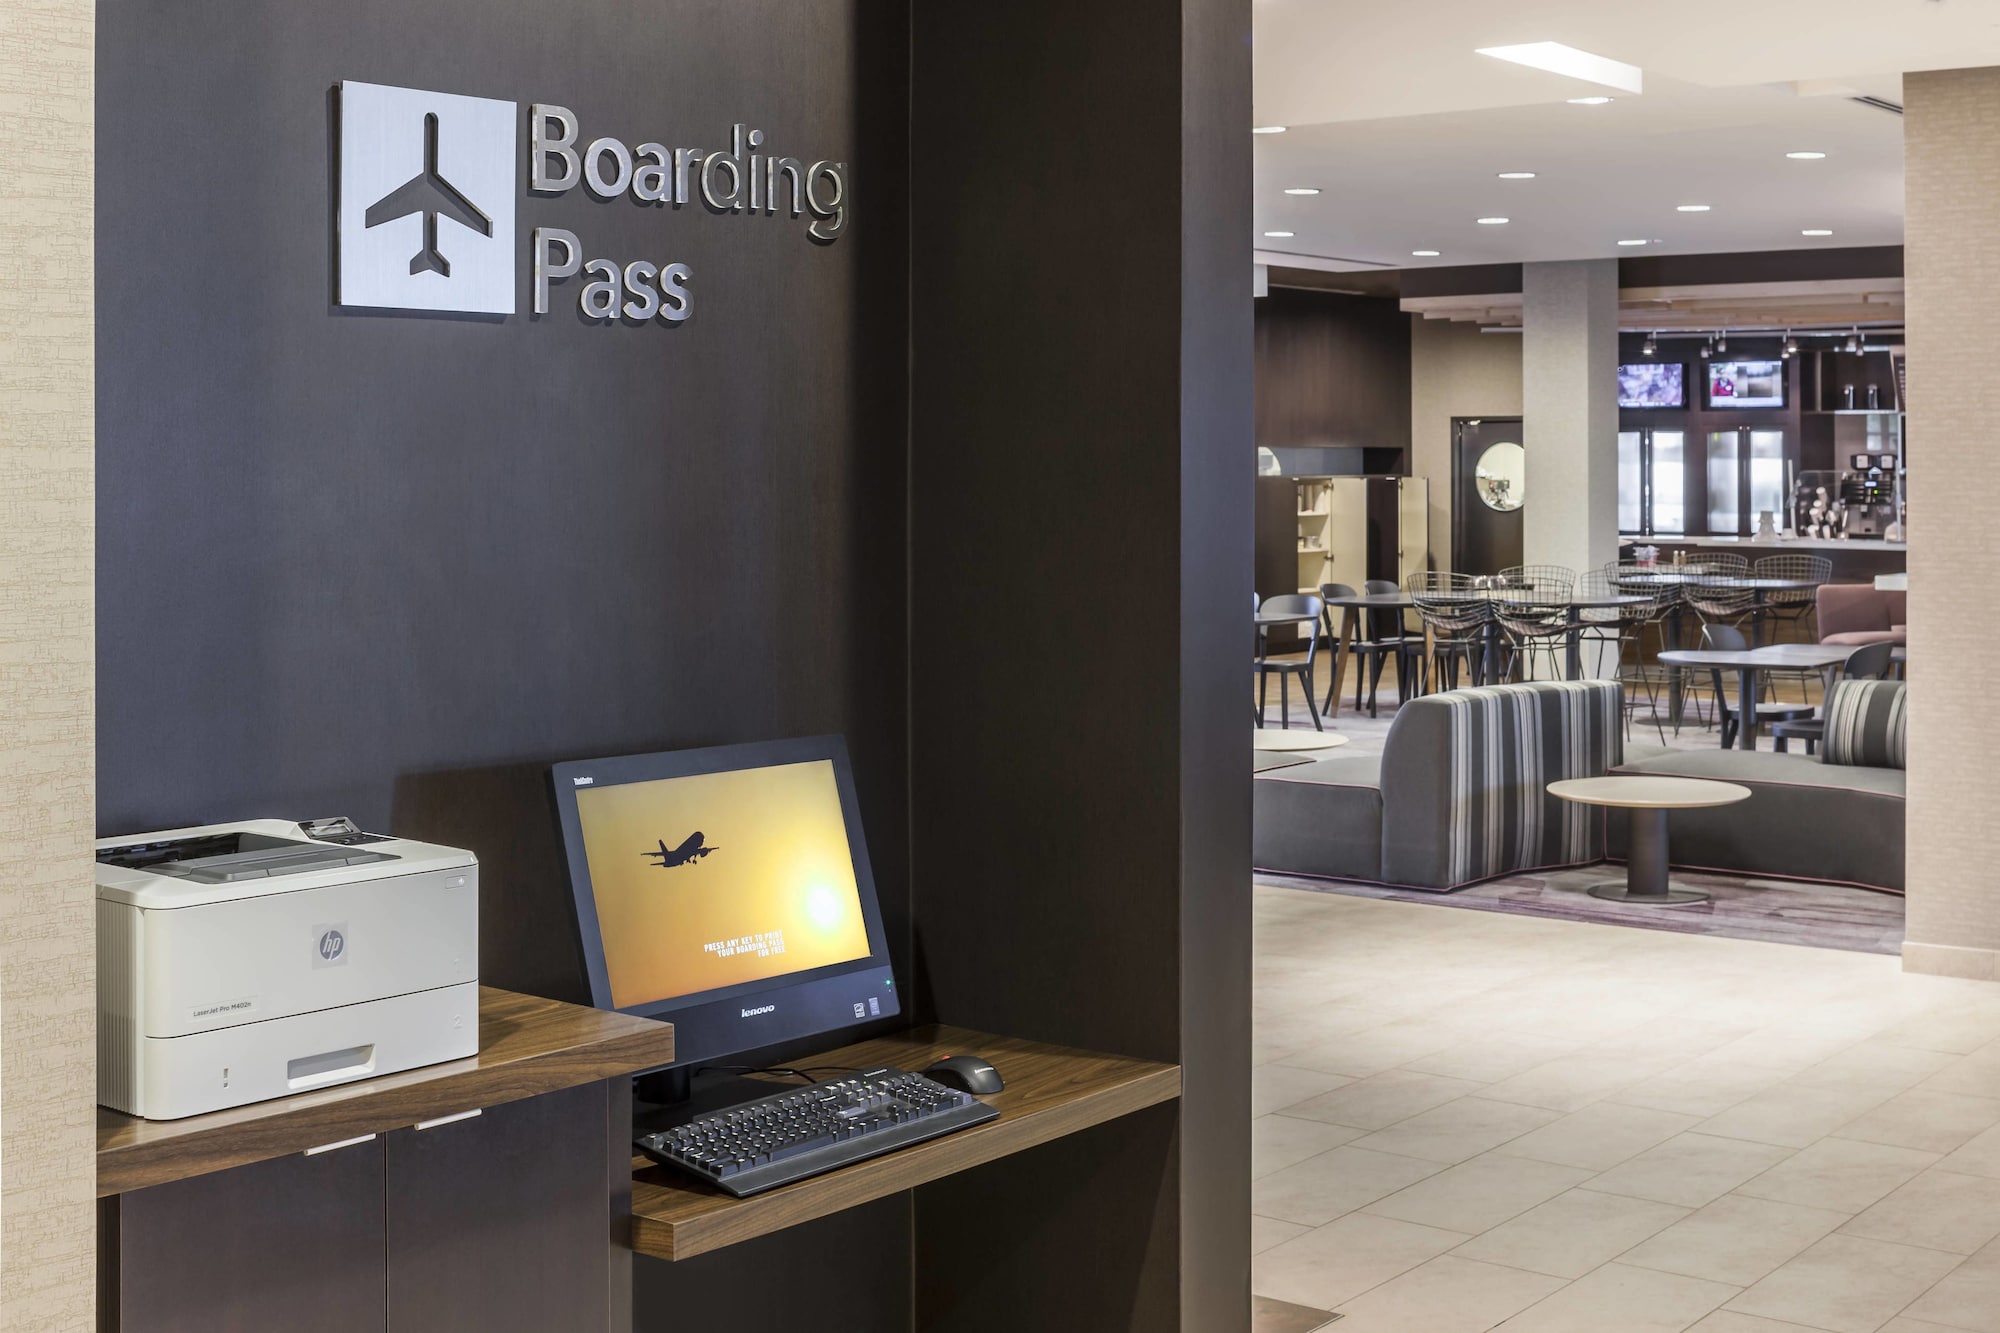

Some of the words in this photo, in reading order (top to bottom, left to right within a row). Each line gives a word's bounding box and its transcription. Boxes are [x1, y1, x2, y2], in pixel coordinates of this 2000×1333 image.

[530, 103, 848, 240] Boarding
[534, 227, 694, 321] Pass
[322, 930, 342, 960] hp
[704, 942, 725, 952] PRESS
[727, 939, 739, 947] ANY
[741, 936, 753, 945] KEY
[718, 948, 735, 957] YOUR
[736, 942, 767, 954] BOARDING
[758, 949, 769, 957] FOR
[193, 1007, 219, 1017] LaserJet
[741, 1004, 775, 1018] lenovo
